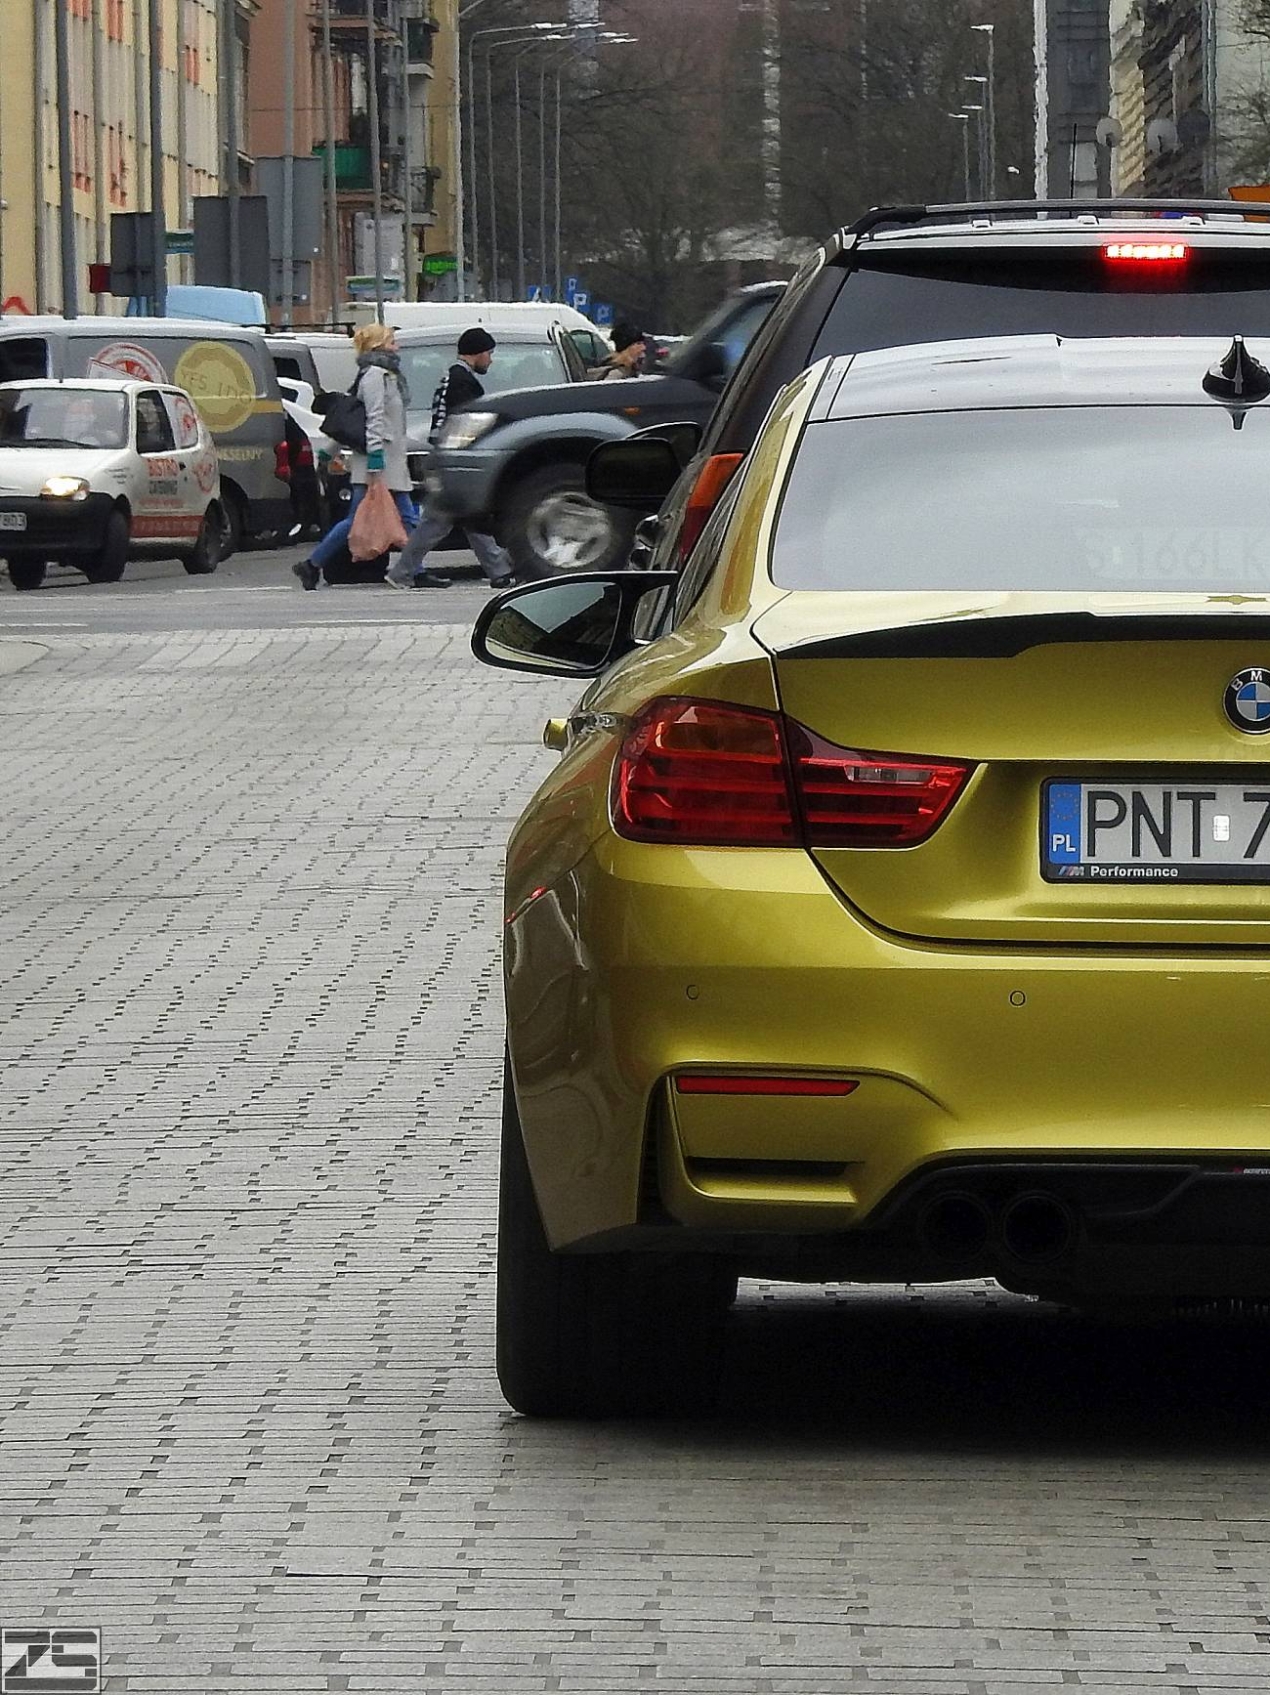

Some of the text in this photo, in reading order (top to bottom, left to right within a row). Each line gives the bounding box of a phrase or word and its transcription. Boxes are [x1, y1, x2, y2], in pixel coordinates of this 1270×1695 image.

[1086, 790, 1217, 859] PNT
[1051, 834, 1077, 853] PL
[1089, 864, 1179, 879] Performance
